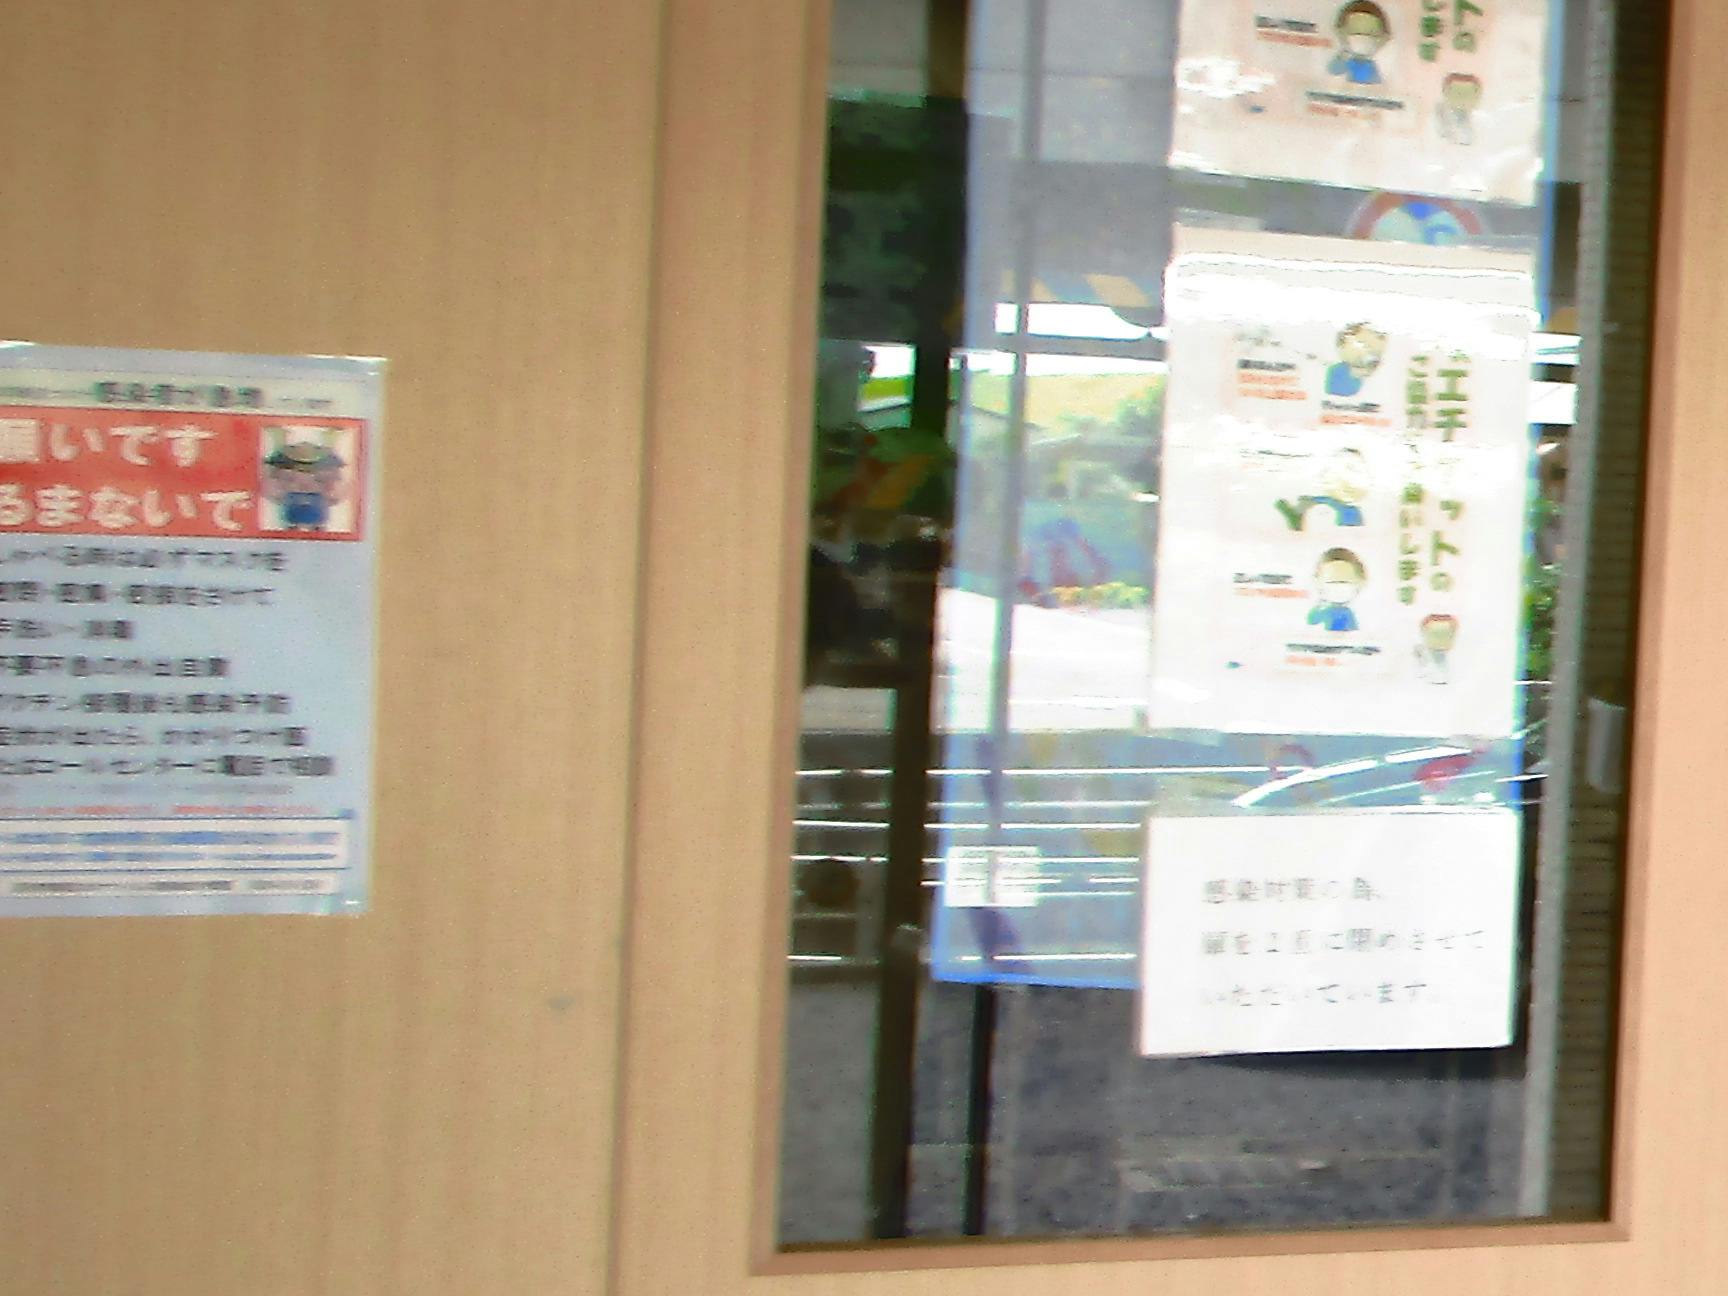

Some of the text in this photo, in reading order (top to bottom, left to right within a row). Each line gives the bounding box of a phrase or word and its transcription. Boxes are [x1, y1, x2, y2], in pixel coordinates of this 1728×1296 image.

[1430, 350, 1470, 591] エチットの
[0, 692, 292, 715] クチン接種後も感染予防
